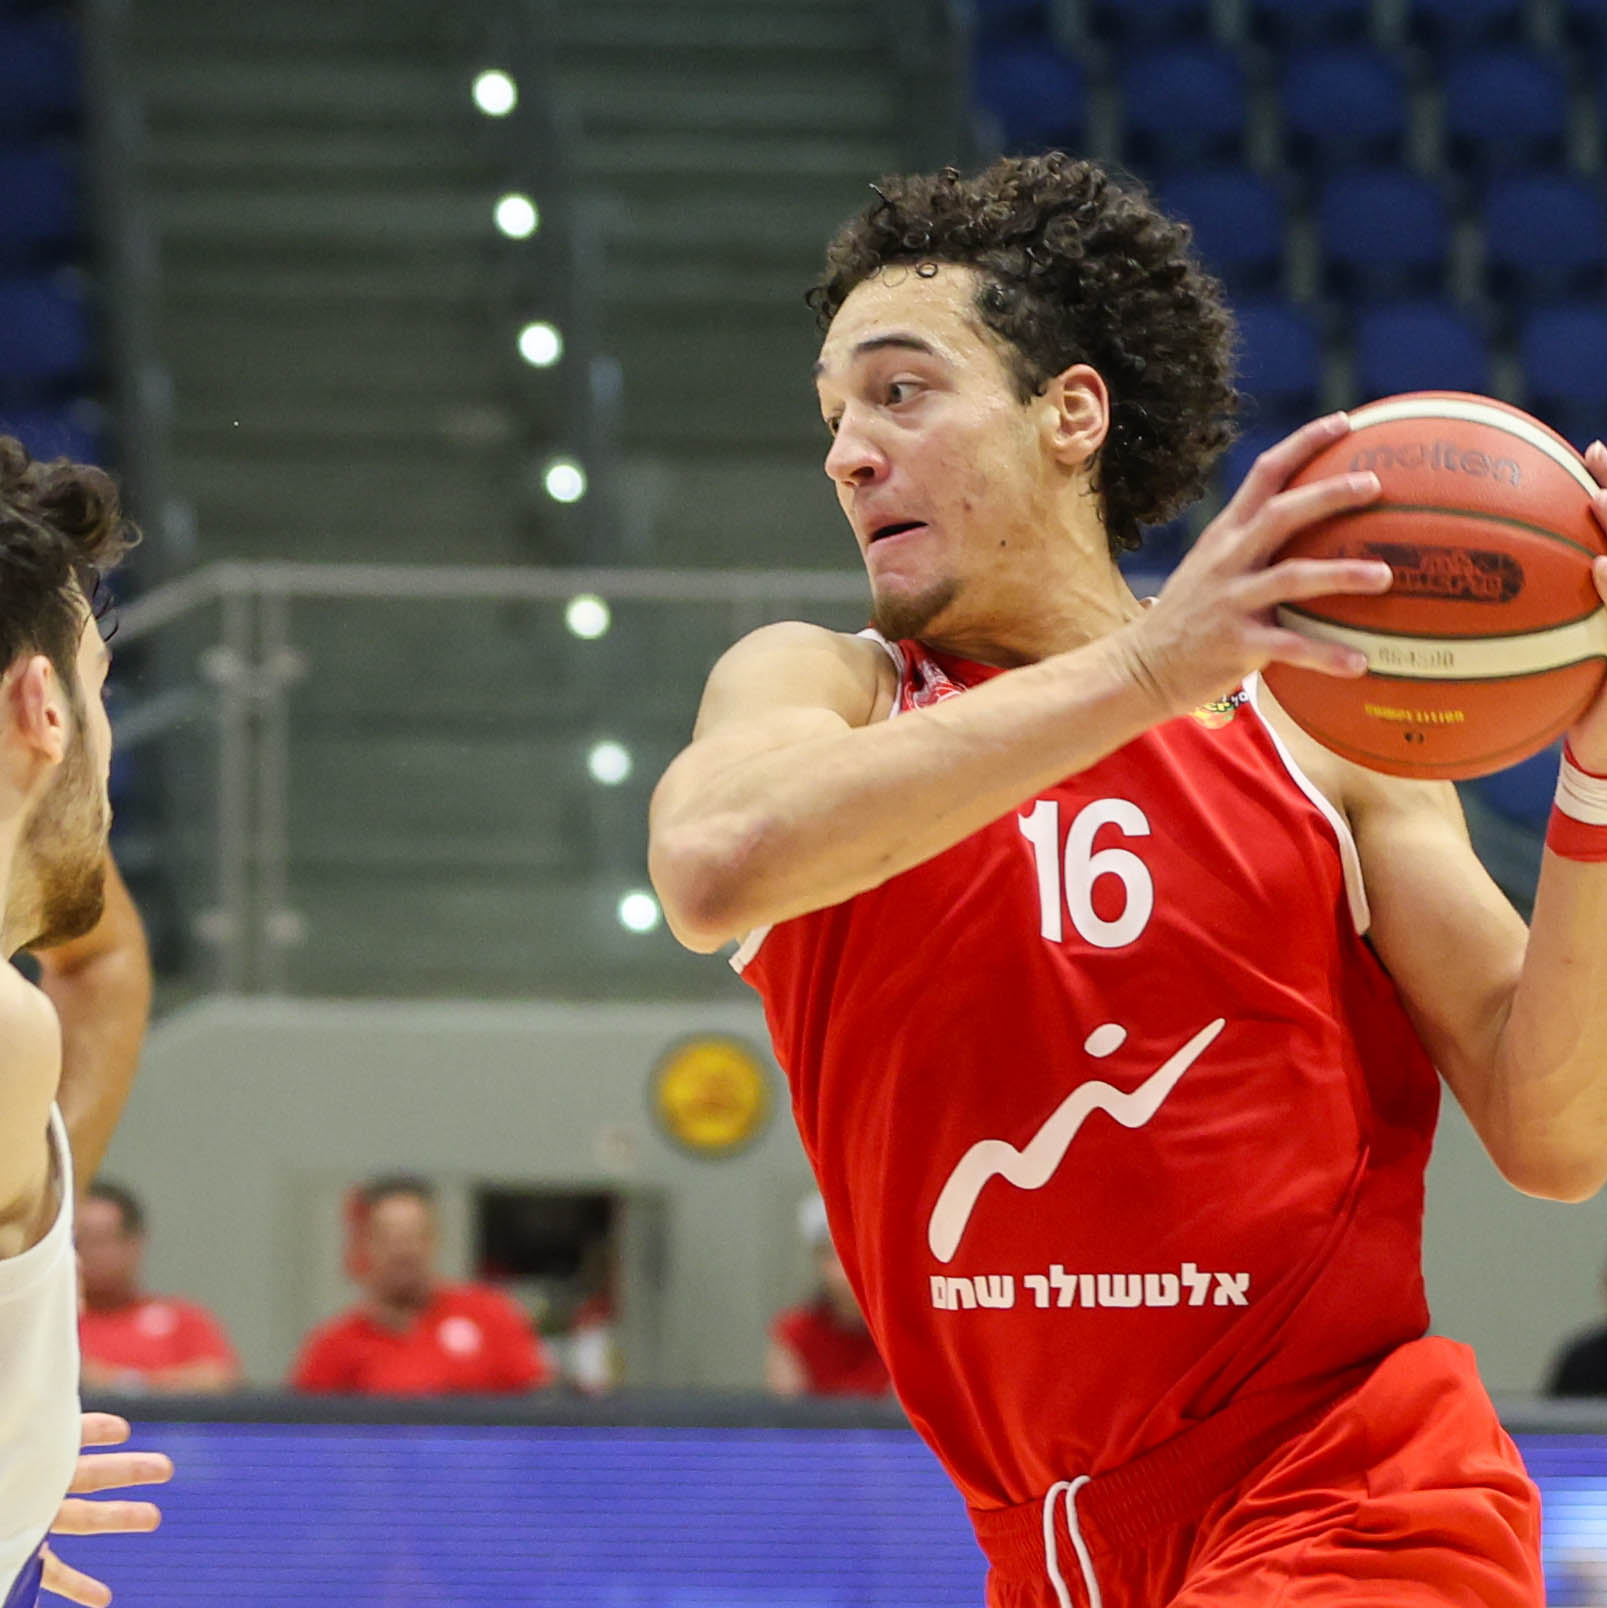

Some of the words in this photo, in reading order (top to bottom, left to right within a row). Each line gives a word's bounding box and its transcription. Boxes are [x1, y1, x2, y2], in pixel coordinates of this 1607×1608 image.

[1349, 440, 1521, 488] molten
[1017, 797, 1155, 949] 16
[929, 1274, 1015, 1311] שחם
[1023, 1262, 1251, 1309] אלטשולר
